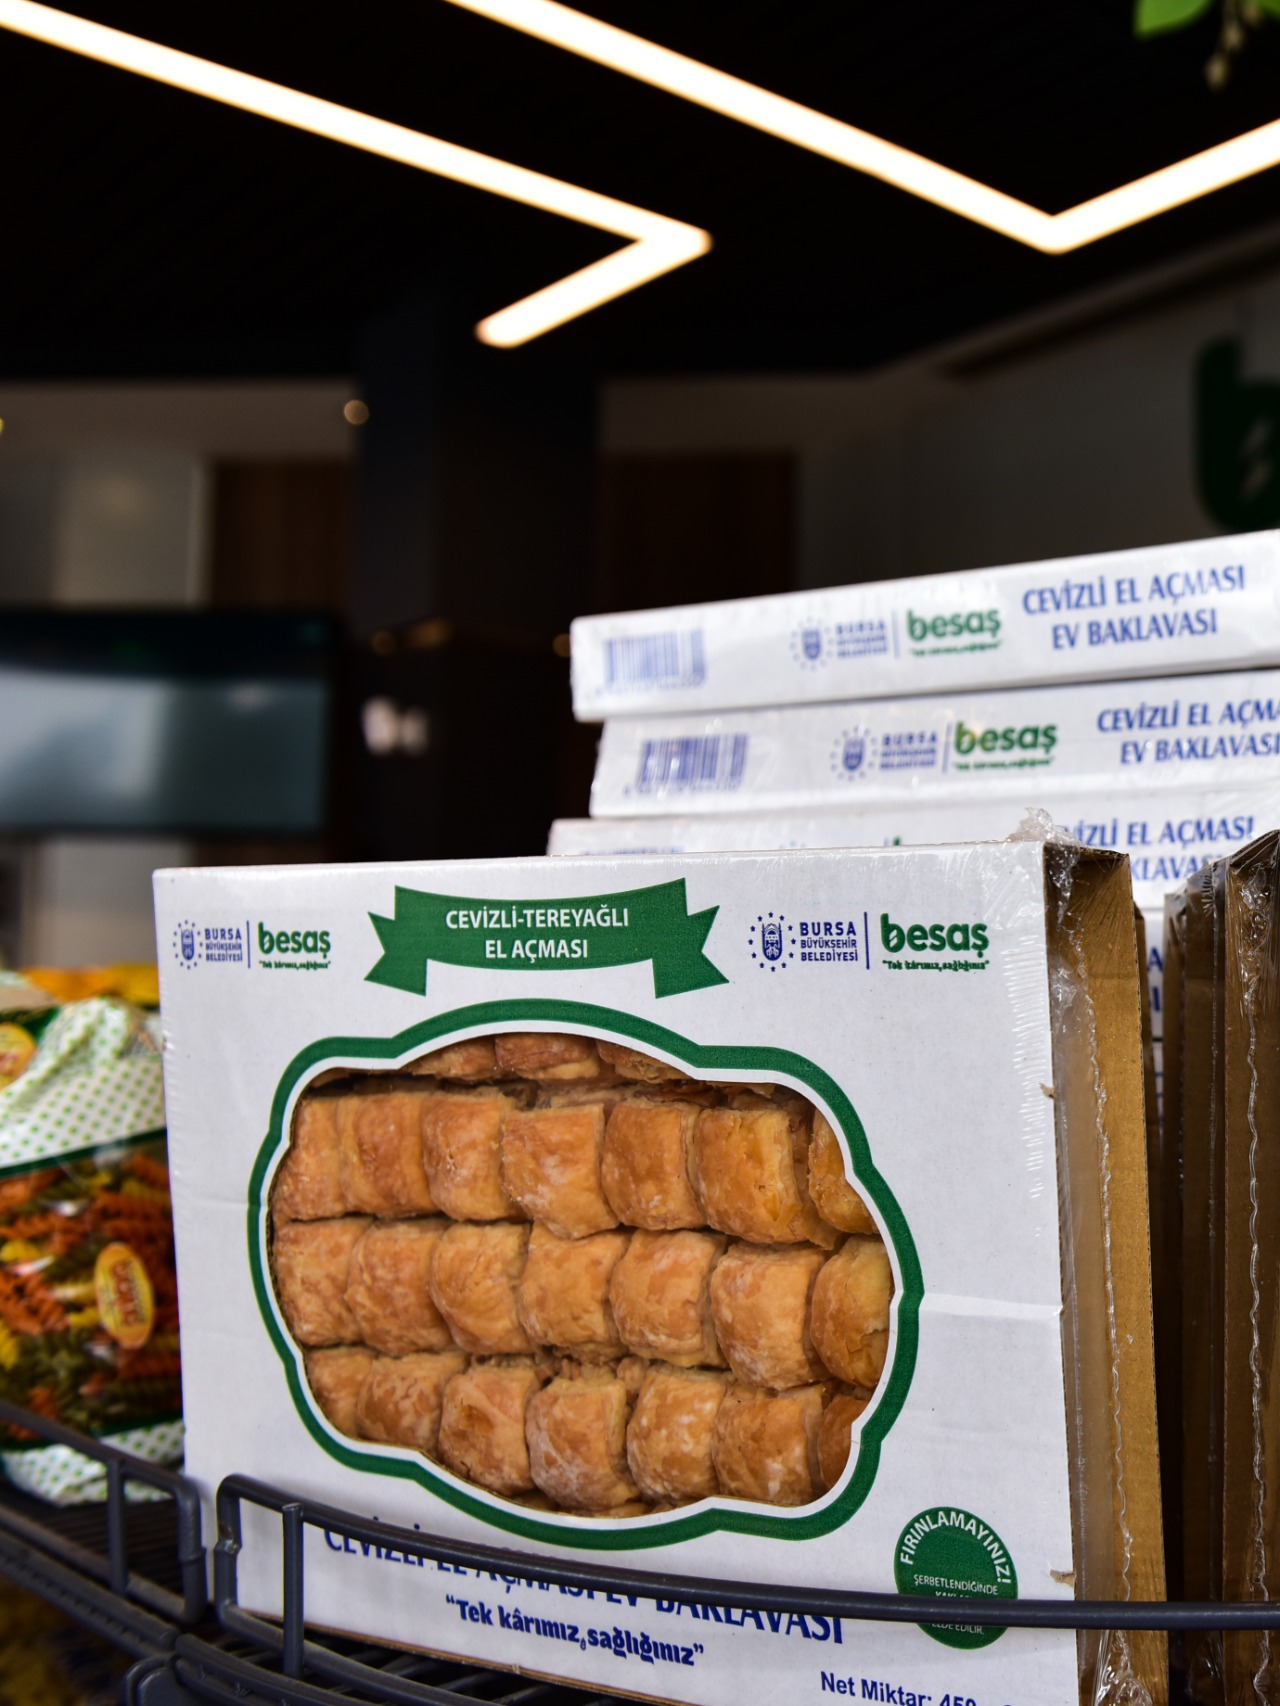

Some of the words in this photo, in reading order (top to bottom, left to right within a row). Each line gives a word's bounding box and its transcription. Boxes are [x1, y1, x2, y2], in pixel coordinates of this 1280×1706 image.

[1022, 576, 1107, 615] CEVİZLİ
[1115, 578, 1141, 605] EL
[1148, 565, 1246, 605] AÇMASI
[907, 608, 1000, 642] besaş
[1051, 622, 1080, 650] EV
[1087, 608, 1218, 647] BAKLAVASI
[1096, 699, 1179, 733] CEVİZLİ
[1187, 702, 1212, 727] EL
[954, 720, 1058, 756] besaş
[1120, 741, 1148, 765] EV
[1126, 822, 1150, 846] EL
[1159, 816, 1256, 849] AÇMASI
[446, 904, 629, 929] CEVİZLİ-TEREYAĞLI
[800, 921, 857, 936] BURSA
[205, 928, 242, 940] BURSA
[258, 921, 331, 959] besaş
[800, 937, 857, 950] BÜYÜKŞEHİR
[880, 912, 989, 958] besaş
[485, 940, 507, 959] EL
[511, 939, 588, 963] AÇMASI
[801, 949, 858, 962] BELEDİYESİ
[900, 1511, 1011, 1584] FIRINLAMAYINIZ!
[913, 1574, 999, 1595] ŞERBETLENDİĞİNDE
[820, 1671, 855, 1696] Net
